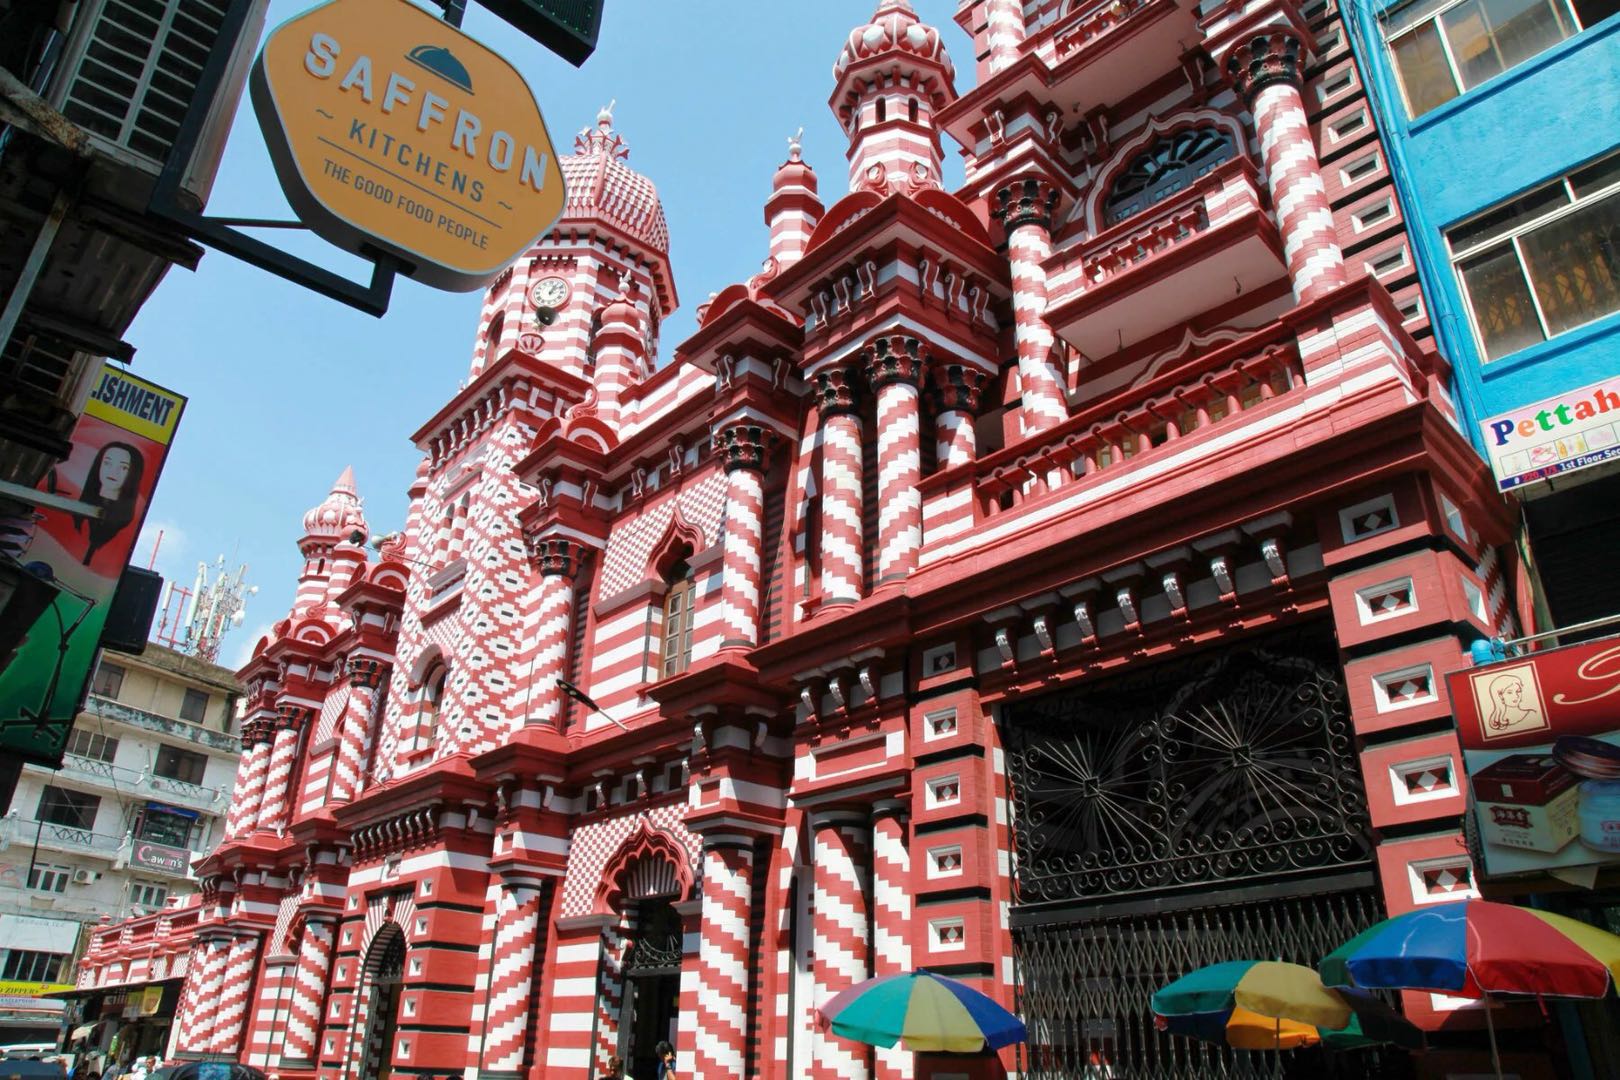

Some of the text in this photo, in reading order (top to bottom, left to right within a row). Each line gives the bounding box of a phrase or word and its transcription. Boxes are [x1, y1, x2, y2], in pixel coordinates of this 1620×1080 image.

[303, 32, 548, 194] SAFFRON
[348, 118, 485, 203] KITCHENS
[323, 158, 489, 250] THE GOOD FOOD PEOPLE
[92, 373, 174, 426] ISHMENT
[1490, 388, 1620, 446] Pettah
[1560, 460, 1576, 471] 1st
